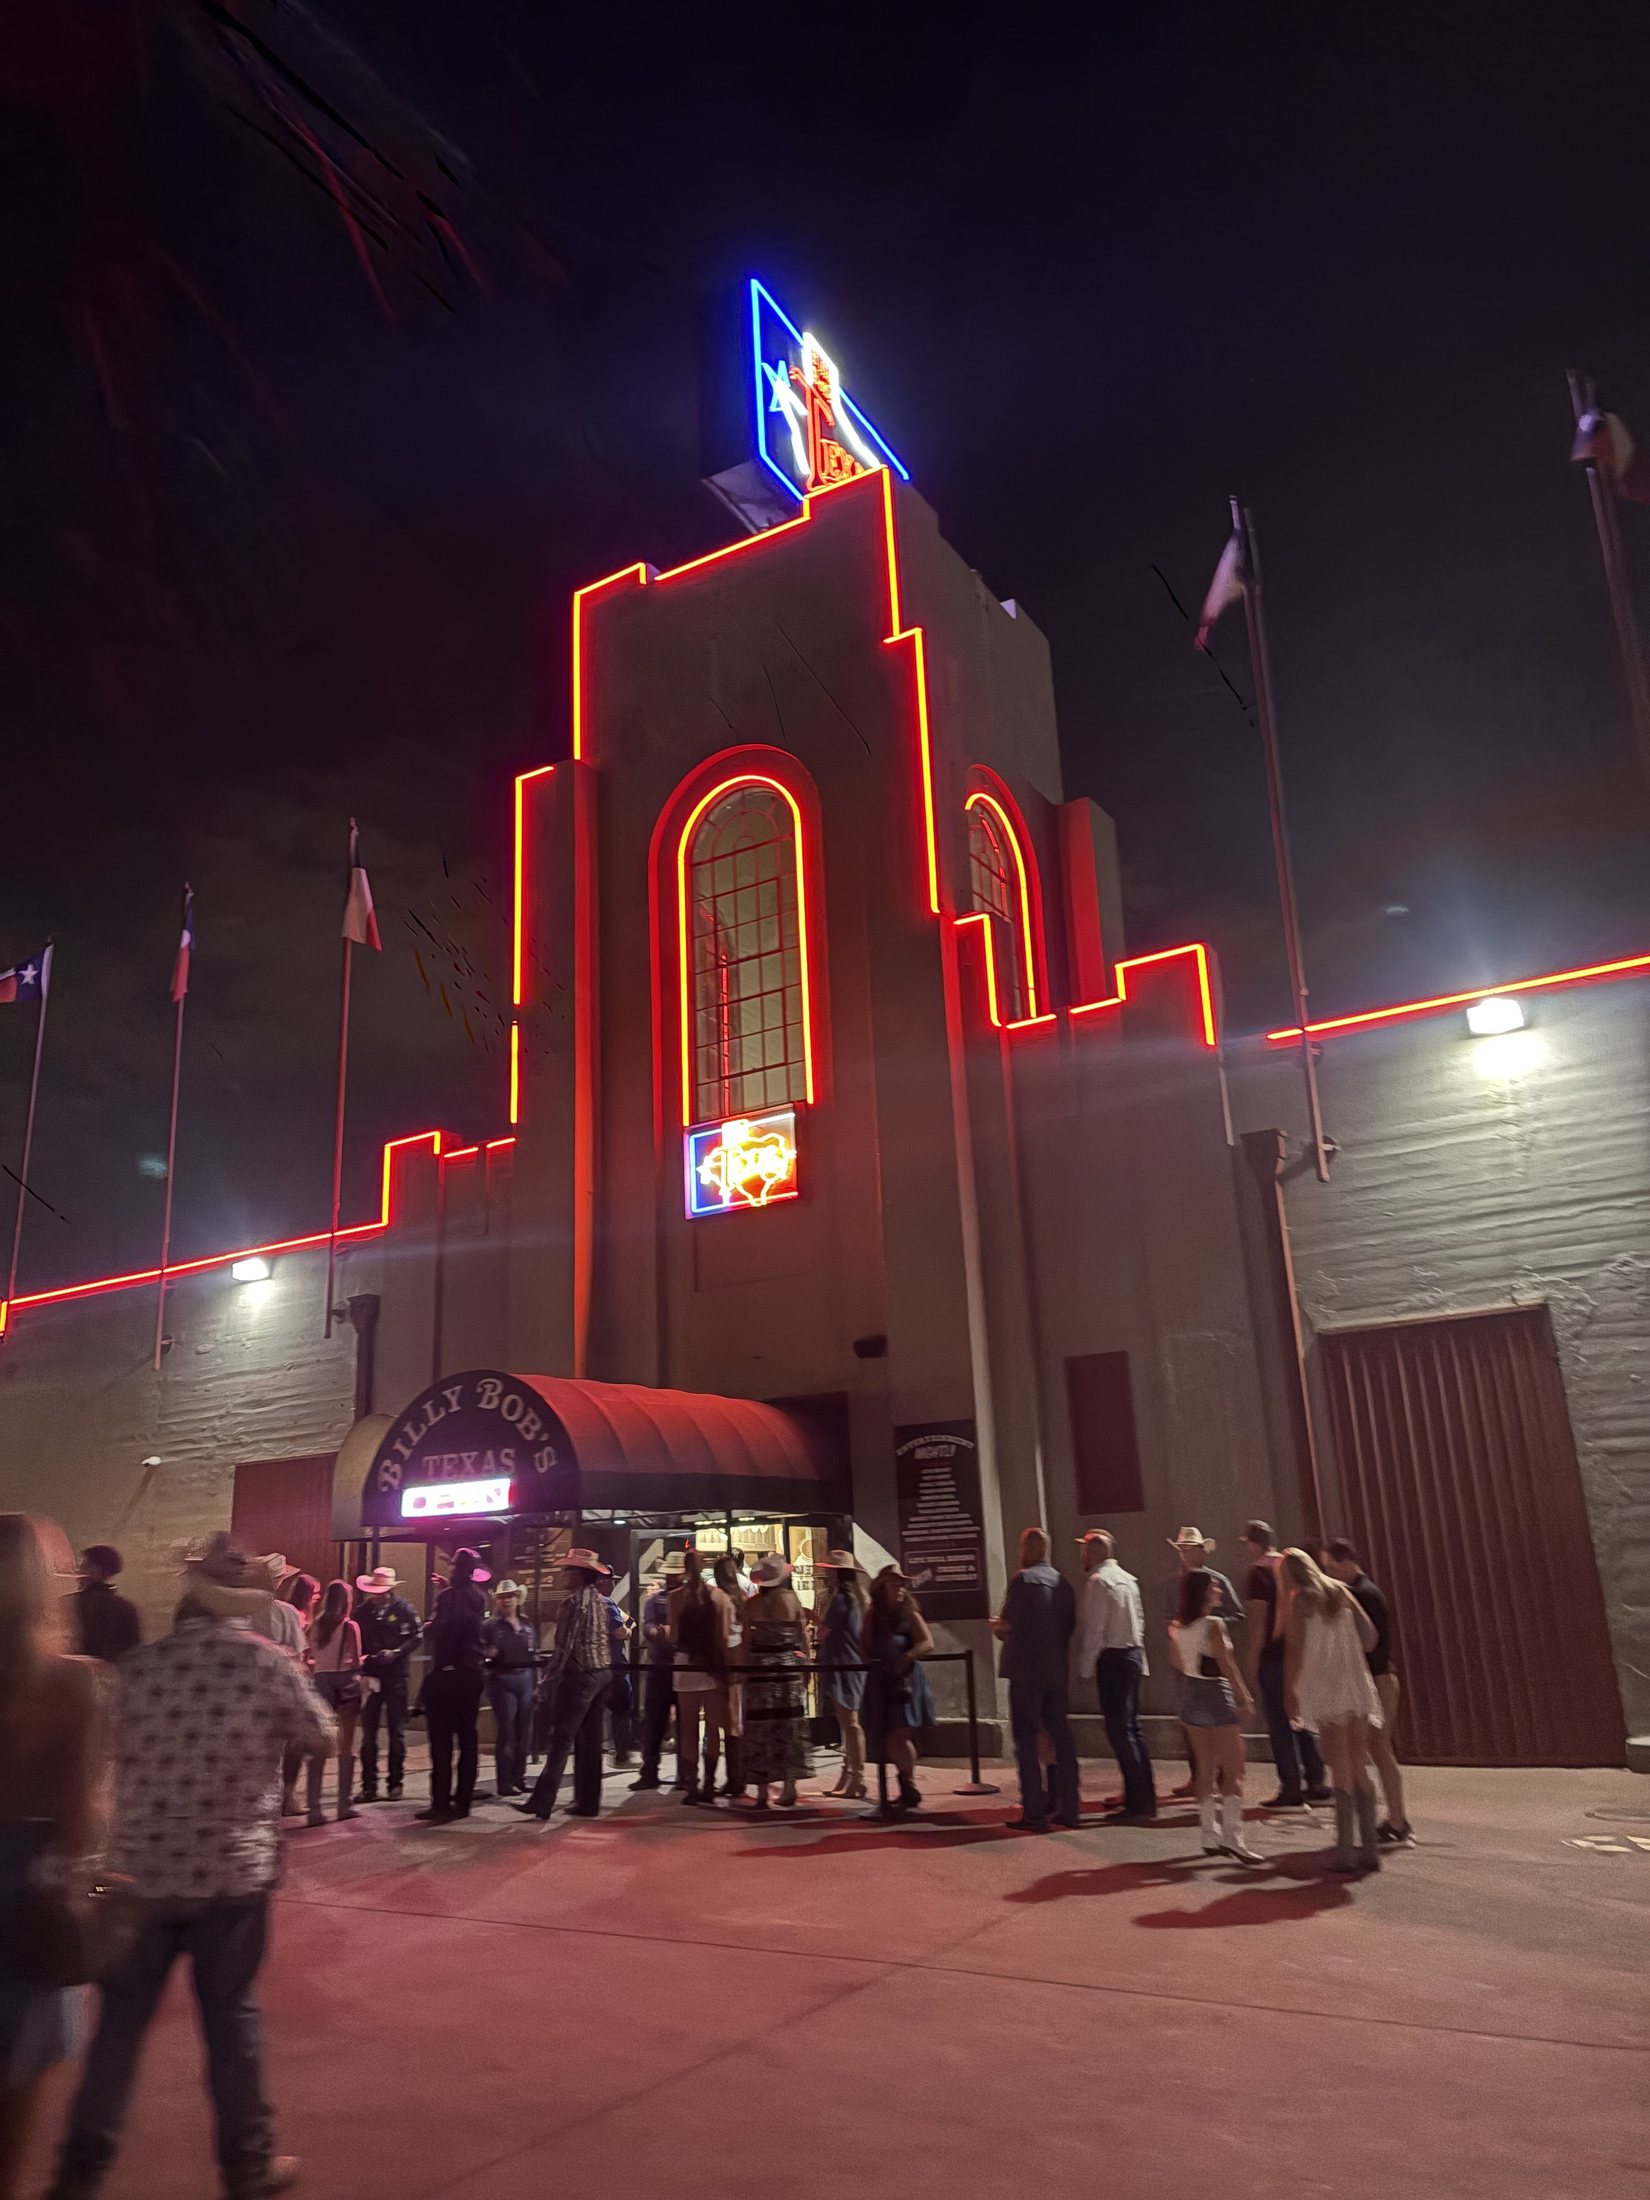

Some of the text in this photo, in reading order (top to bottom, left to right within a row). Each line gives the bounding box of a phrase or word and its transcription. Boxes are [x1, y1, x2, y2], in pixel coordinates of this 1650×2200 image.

[377, 1377, 559, 1492] BILLY BOB'S
[421, 1448, 518, 1481] TEXAS
